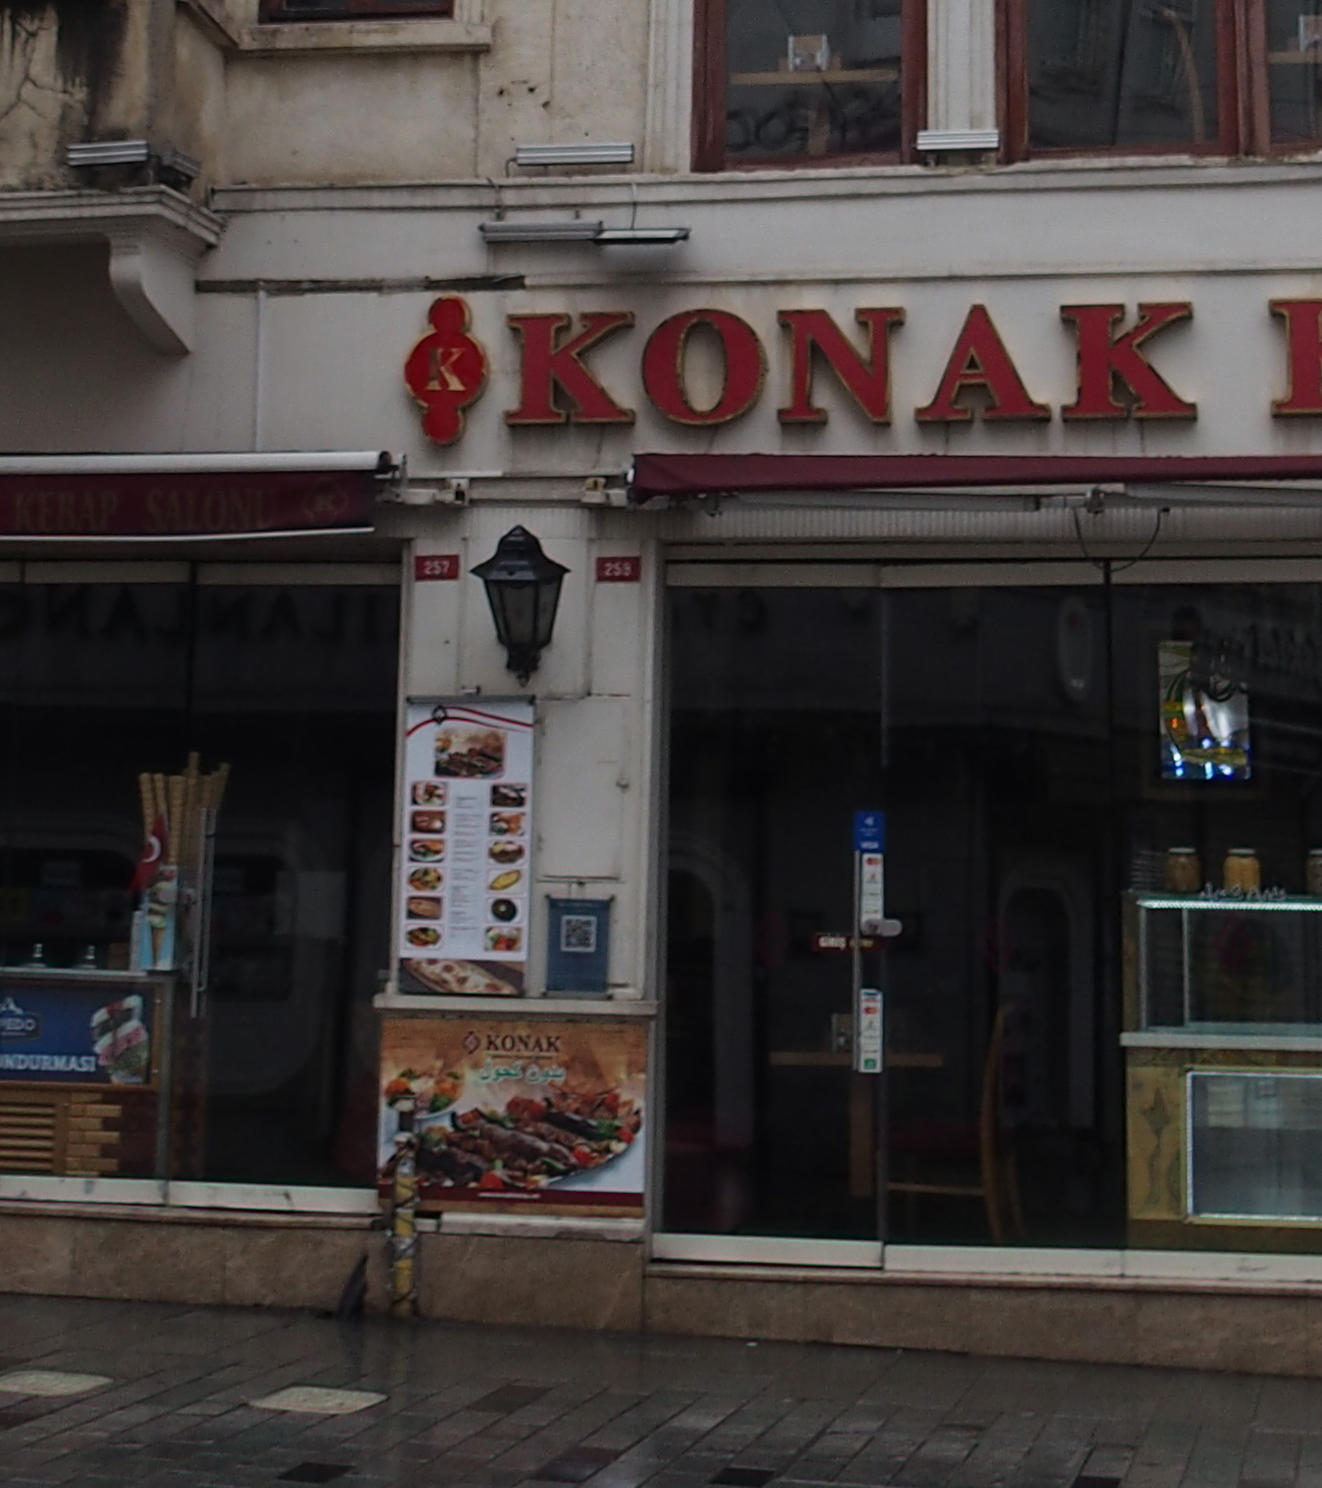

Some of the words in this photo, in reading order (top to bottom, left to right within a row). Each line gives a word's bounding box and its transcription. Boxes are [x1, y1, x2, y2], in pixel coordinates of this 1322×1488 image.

[426, 345, 466, 392] K
[505, 304, 1198, 426] KONAK
[15, 490, 117, 530] KEBAP
[146, 489, 277, 532] SALONU
[423, 559, 451, 575] 257
[485, 1034, 561, 1054] KONAK
